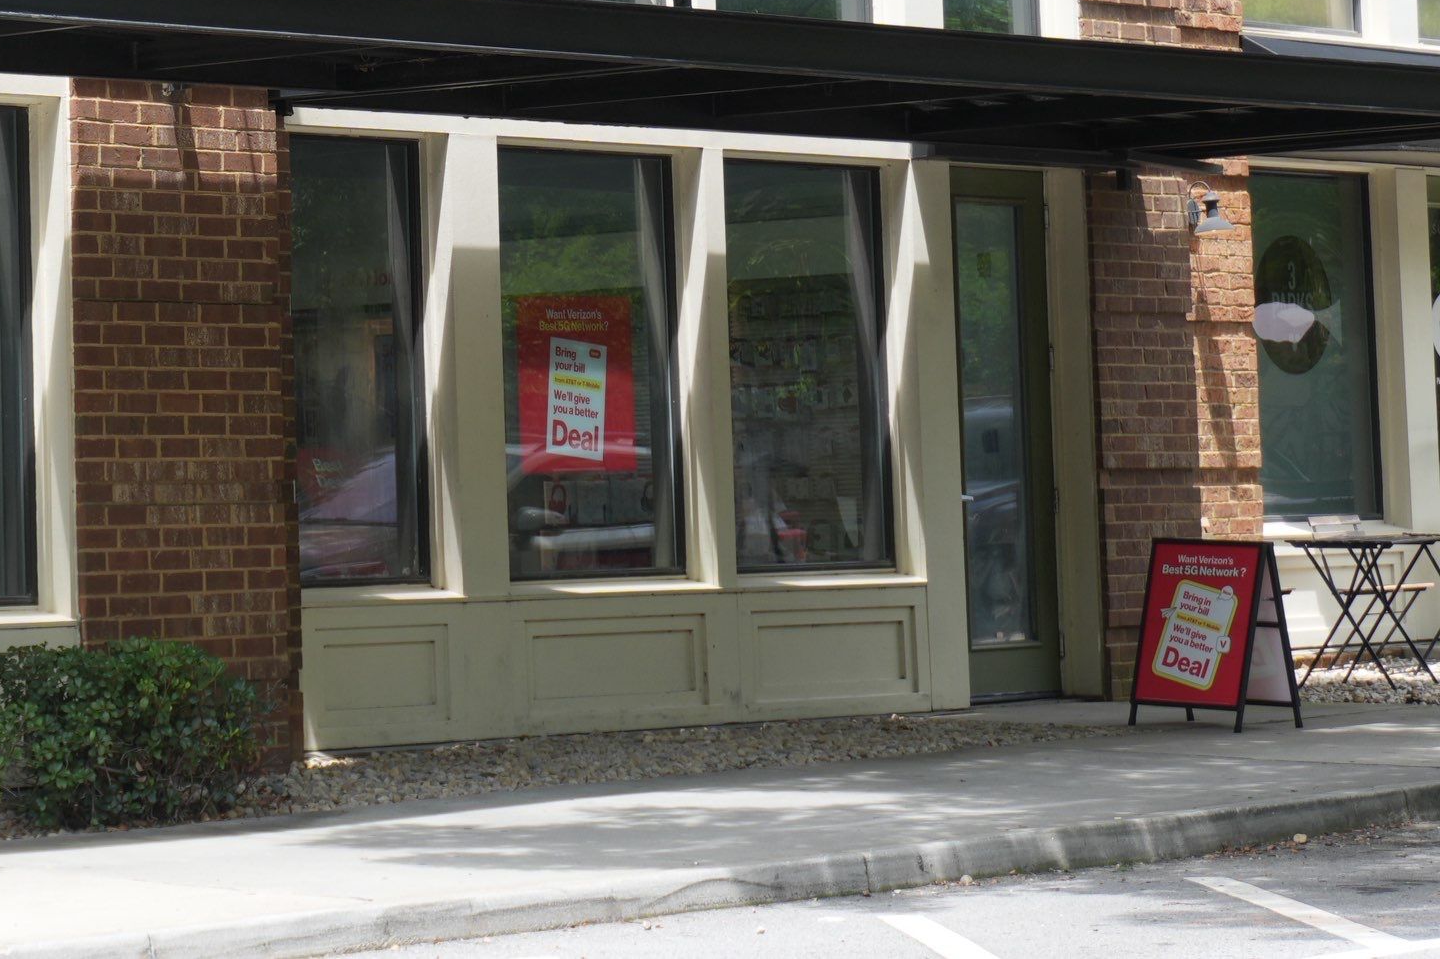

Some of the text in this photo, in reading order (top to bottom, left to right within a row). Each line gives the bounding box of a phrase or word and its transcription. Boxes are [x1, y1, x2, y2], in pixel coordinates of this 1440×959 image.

[1287, 261, 1296, 290] 3
[546, 308, 602, 320] Want Verizon's
[539, 321, 558, 331] Best
[555, 346, 577, 361] Bring
[555, 361, 586, 374] your bill
[553, 389, 591, 405] We'll give
[553, 405, 599, 419] you a better
[551, 419, 599, 452] Deal
[1177, 554, 1234, 565] Want Verizon's
[1162, 564, 1183, 574] Best
[1184, 565, 1199, 575] 5G
[1199, 566, 1239, 577] Network
[1182, 590, 1211, 607] Bring in
[1179, 602, 1210, 616] your bill
[1173, 623, 1207, 641] We'll give
[1168, 634, 1184, 644] you
[1189, 640, 1214, 653] better
[1161, 645, 1211, 679] Deal
